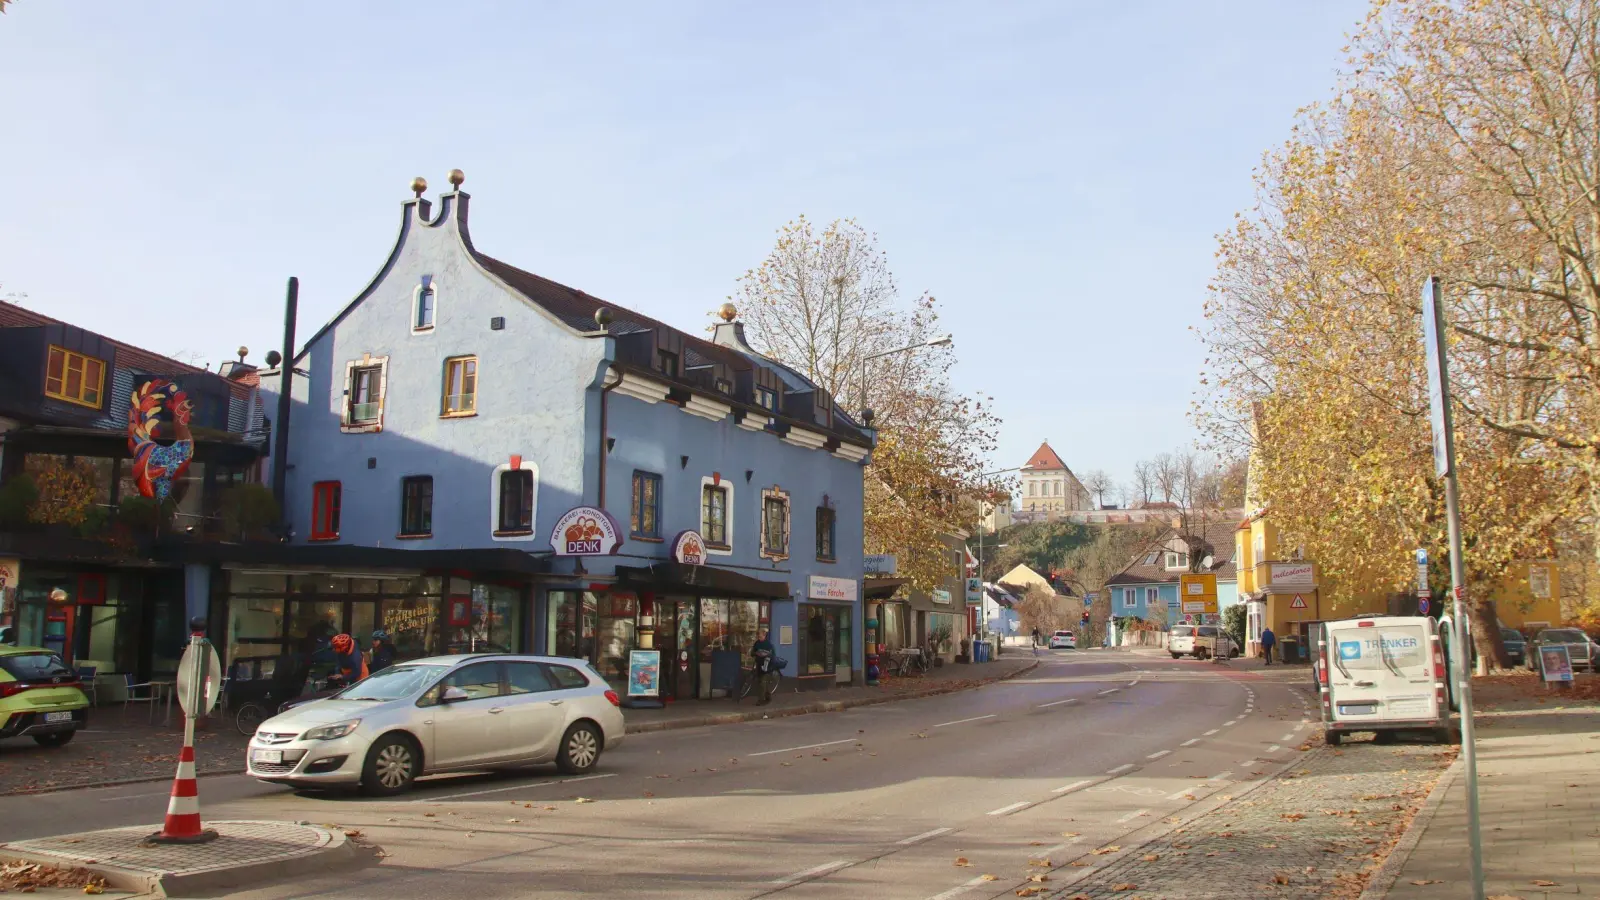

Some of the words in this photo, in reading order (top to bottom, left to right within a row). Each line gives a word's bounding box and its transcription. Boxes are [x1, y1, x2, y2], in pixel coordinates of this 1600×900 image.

[582, 509, 614, 538] KONDITOREI
[568, 541, 599, 552] DENK
[684, 555, 700, 563] DENK
[421, 616, 436, 625] Uhr
[1365, 638, 1417, 648] TRENKER
